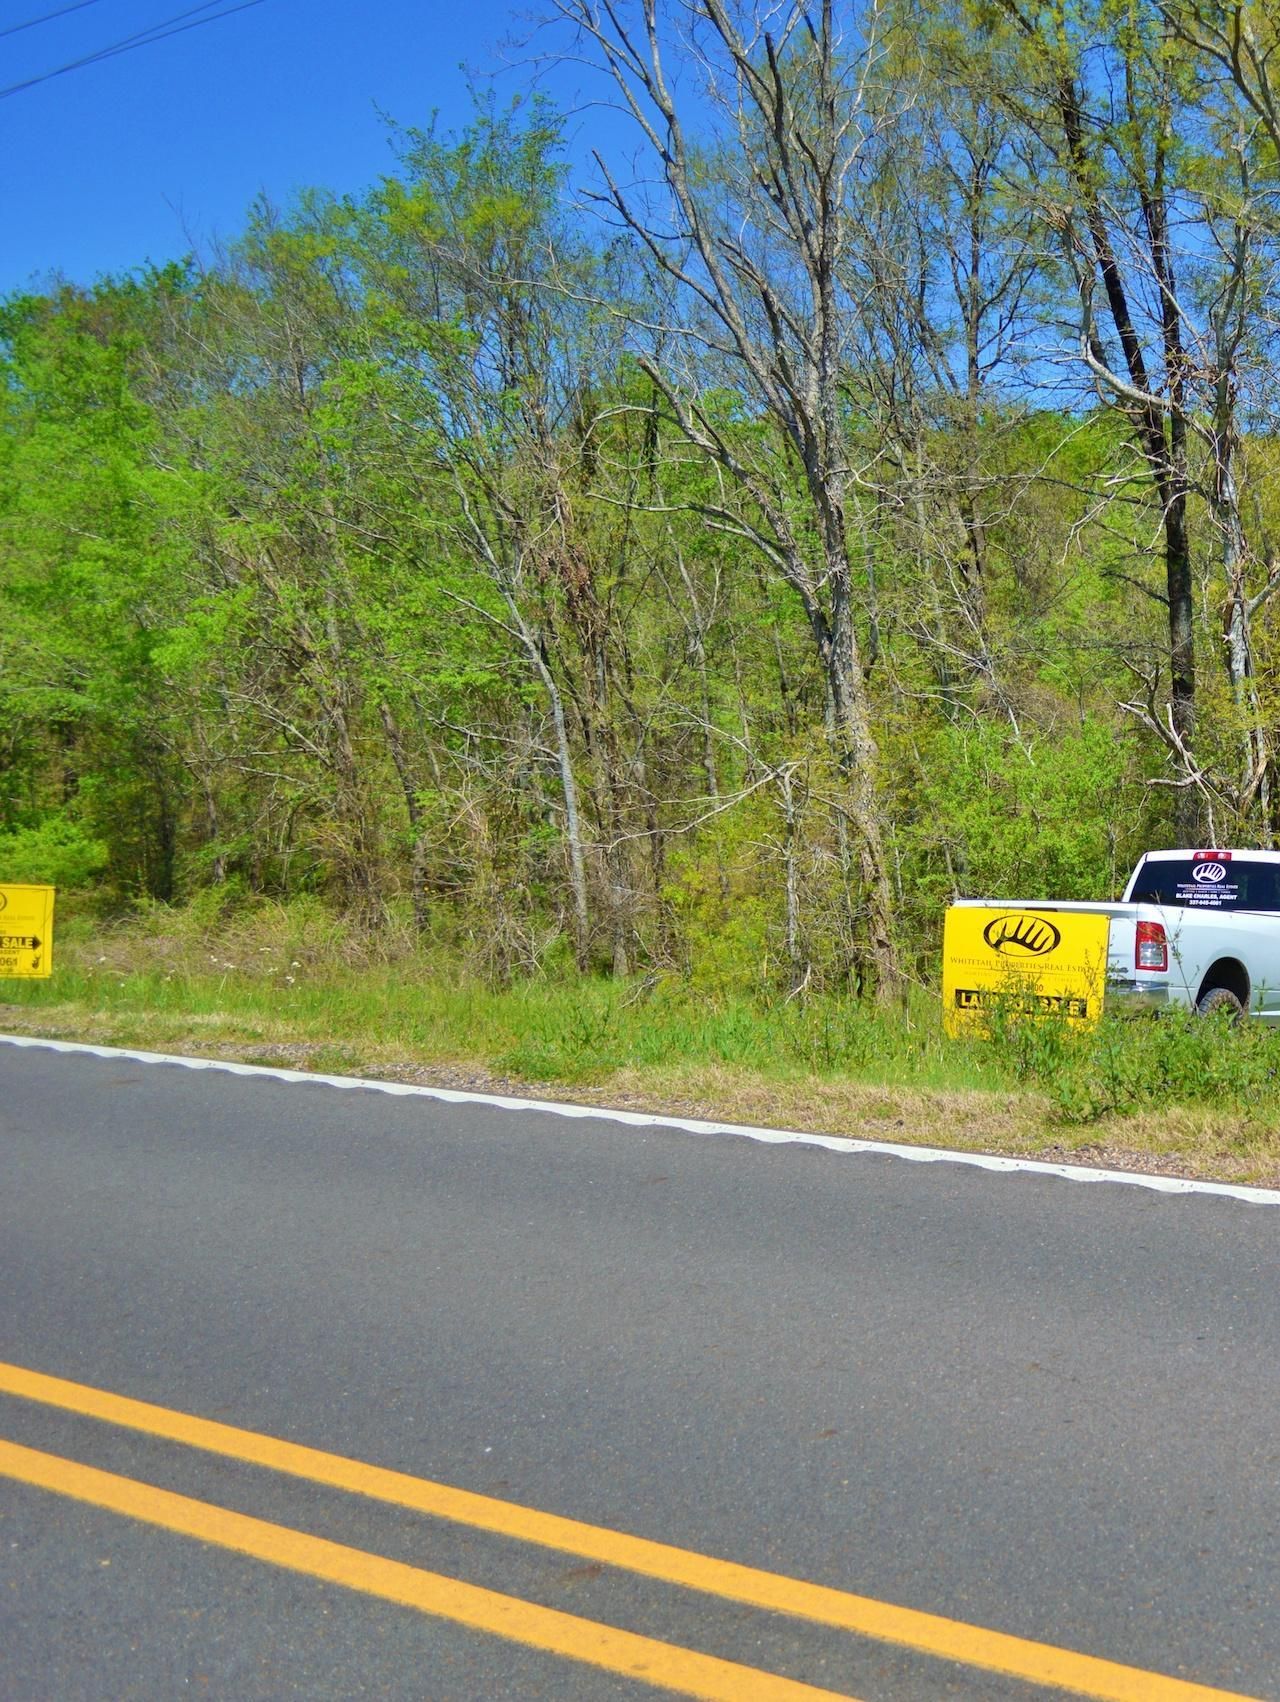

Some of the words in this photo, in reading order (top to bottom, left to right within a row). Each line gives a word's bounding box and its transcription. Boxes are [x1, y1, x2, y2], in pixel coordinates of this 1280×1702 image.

[2, 937, 33, 949] SALE
[1045, 962, 1063, 971] REAL
[1040, 998, 1080, 1017] SAE
